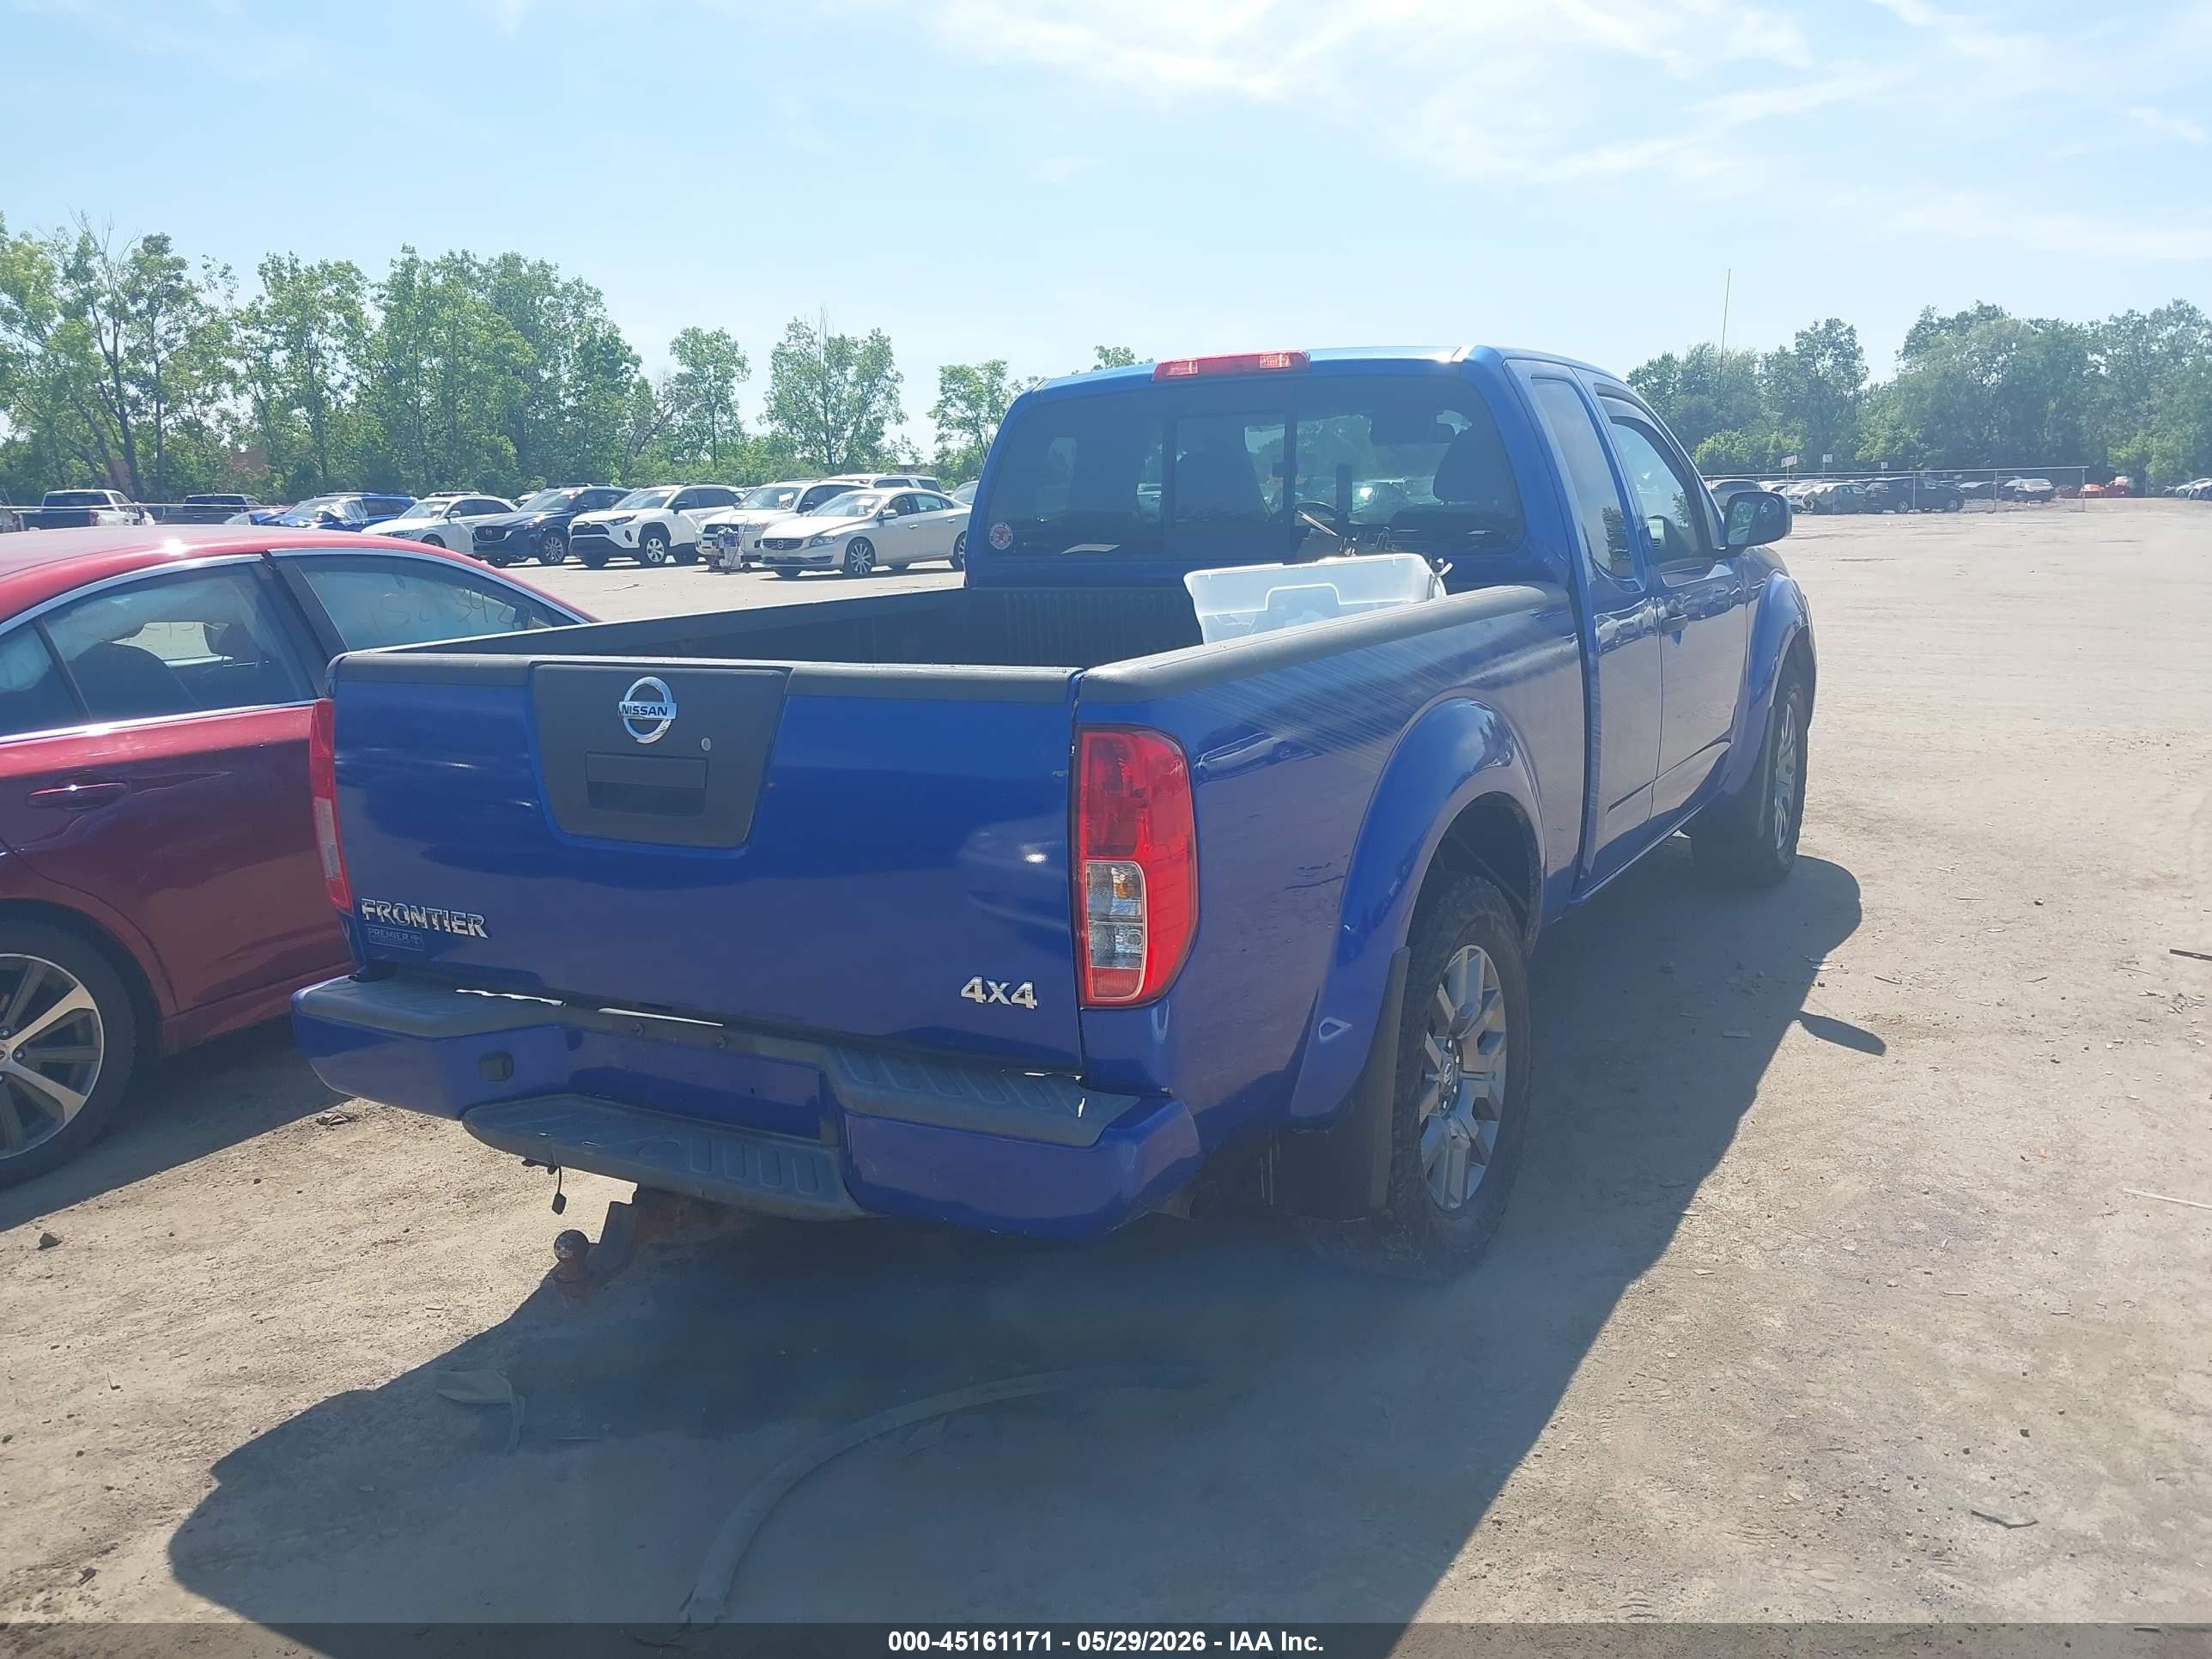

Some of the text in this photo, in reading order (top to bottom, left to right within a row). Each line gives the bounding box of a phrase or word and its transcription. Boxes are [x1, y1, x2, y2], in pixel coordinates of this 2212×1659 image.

[620, 703, 668, 717] NISSAN
[361, 897, 489, 939] FRONTIER
[368, 927, 410, 941] PREMIER
